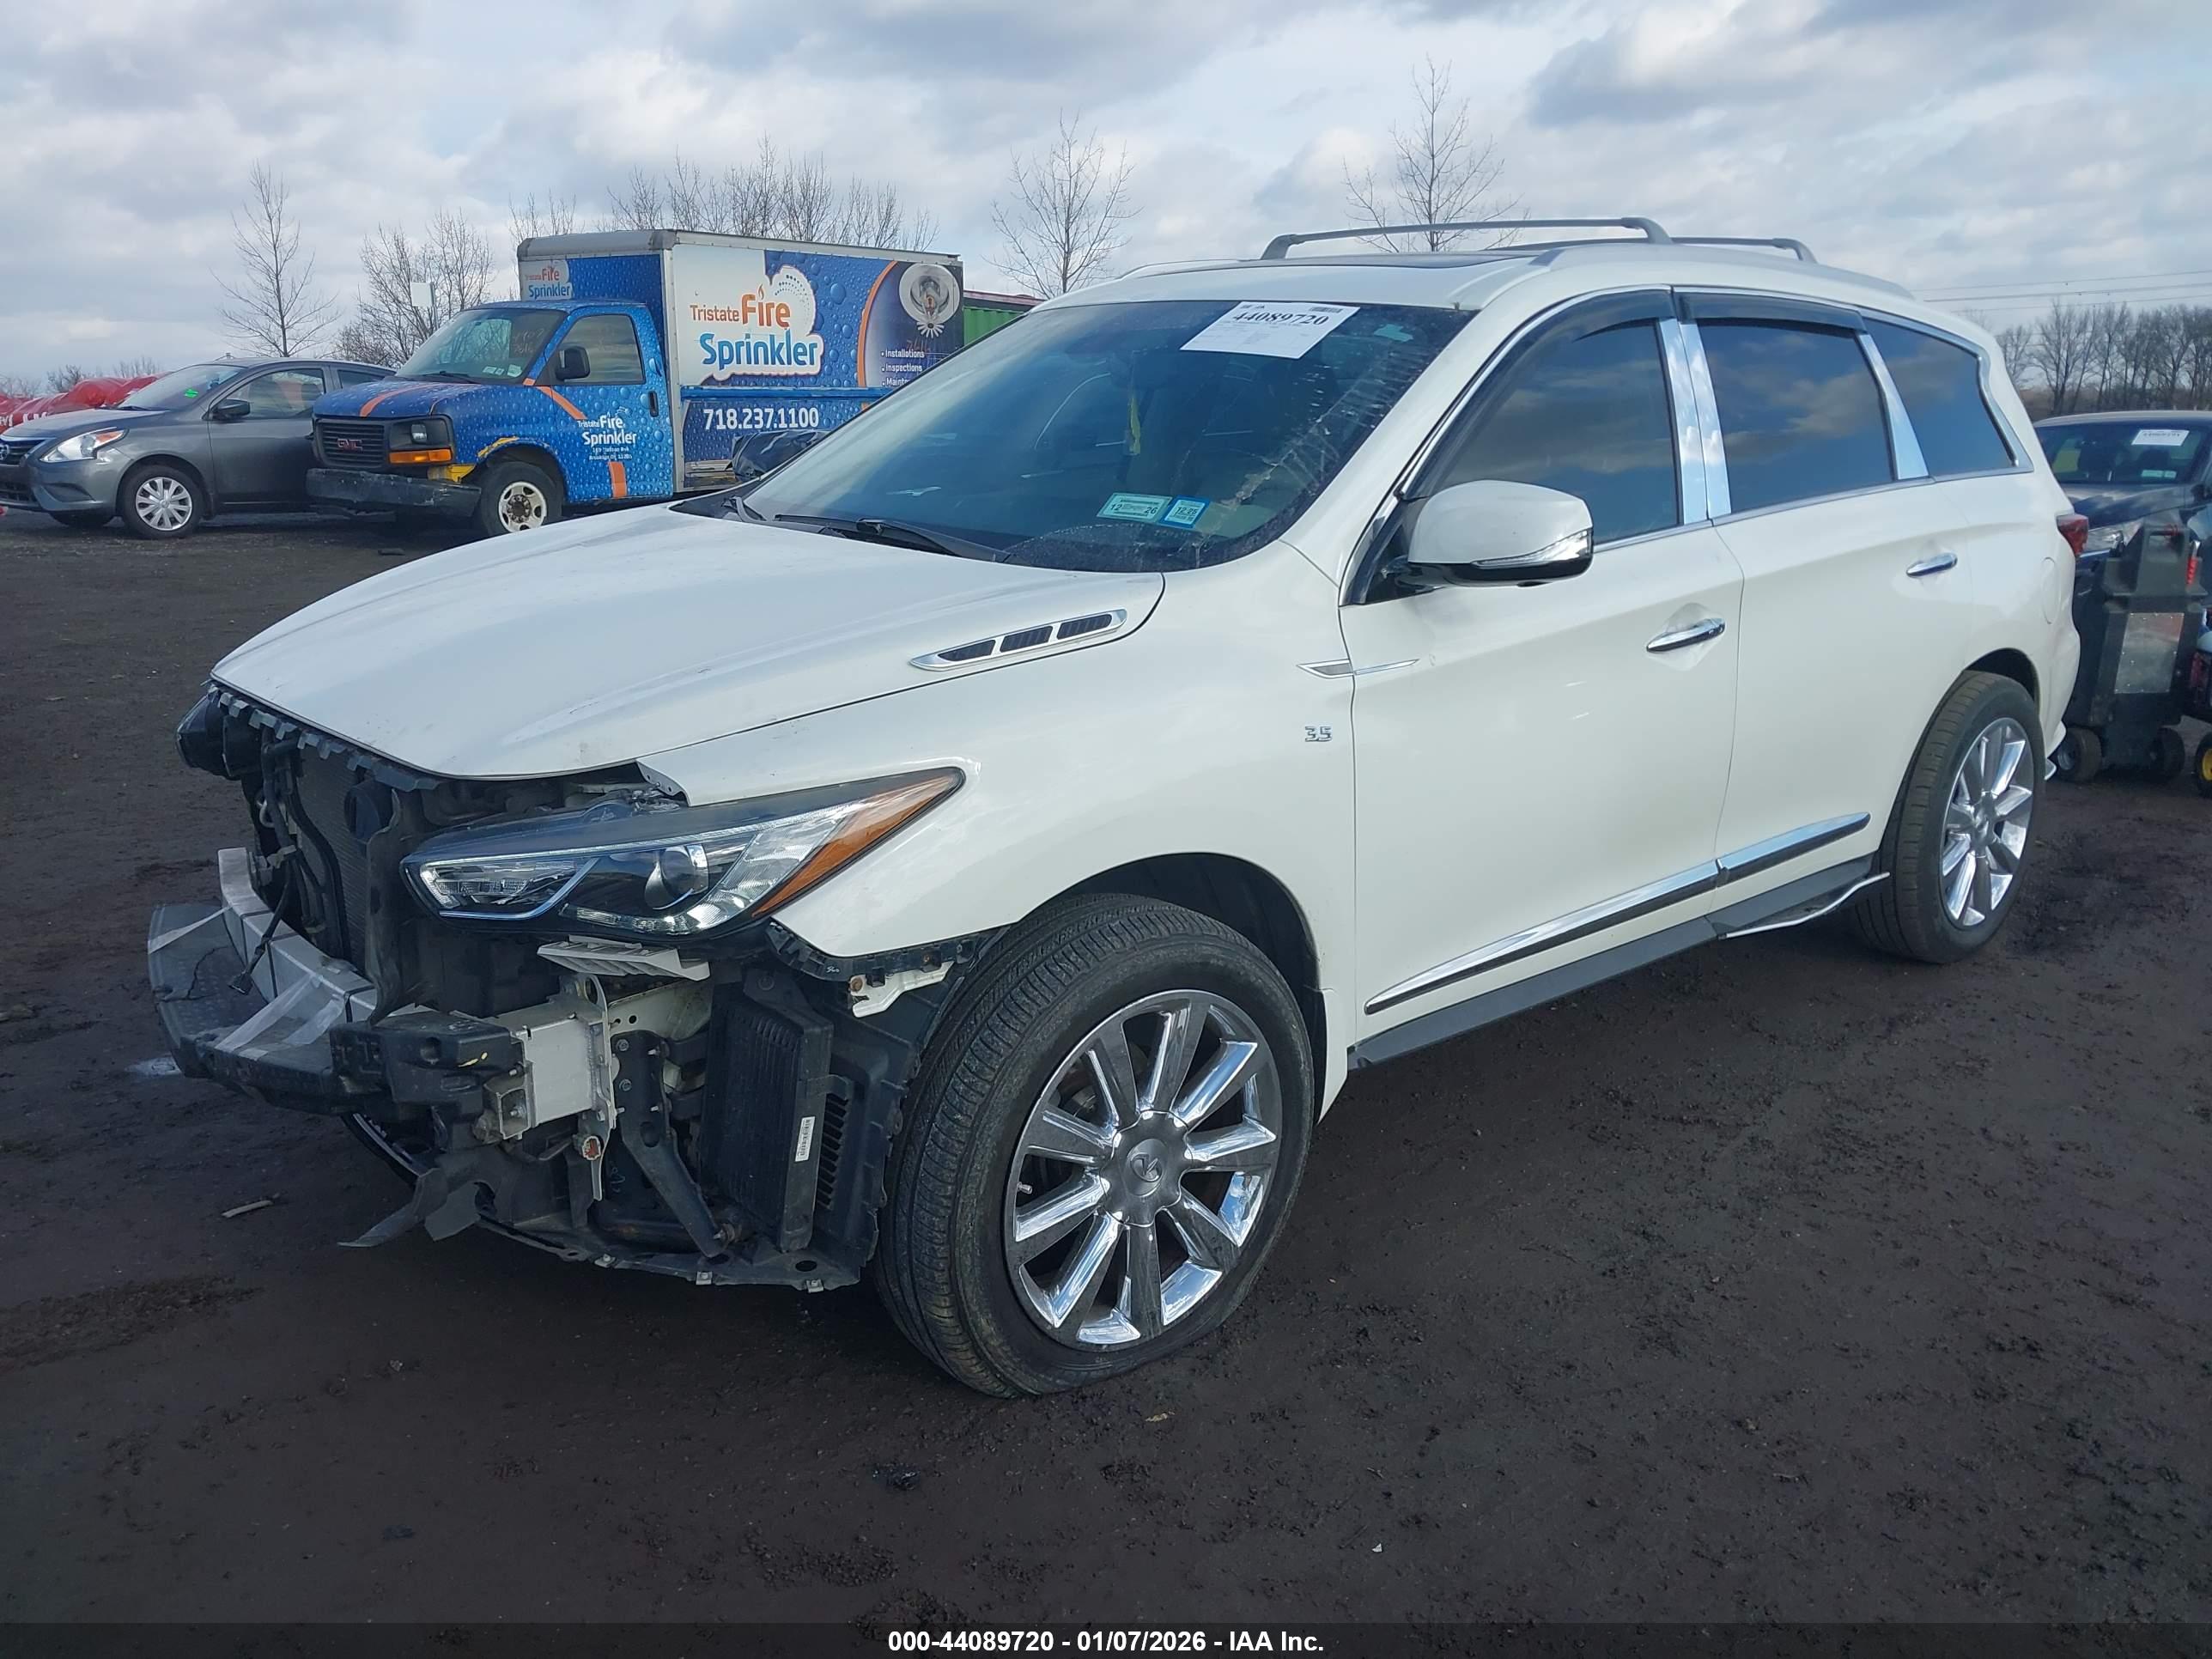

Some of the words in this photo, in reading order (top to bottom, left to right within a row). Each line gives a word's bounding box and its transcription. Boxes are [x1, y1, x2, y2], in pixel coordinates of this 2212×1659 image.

[542, 267, 560, 281] Fire
[528, 282, 570, 299] Sprinkler
[690, 304, 740, 322] Tristate
[741, 292, 791, 328] Fire
[1232, 312, 1329, 325] 44089720
[700, 329, 817, 371] Sprinkler
[885, 363, 923, 373] Inspections
[600, 415, 623, 428] Fire
[703, 407, 819, 429] 718.237.1100
[581, 429, 637, 447] Sprinkler
